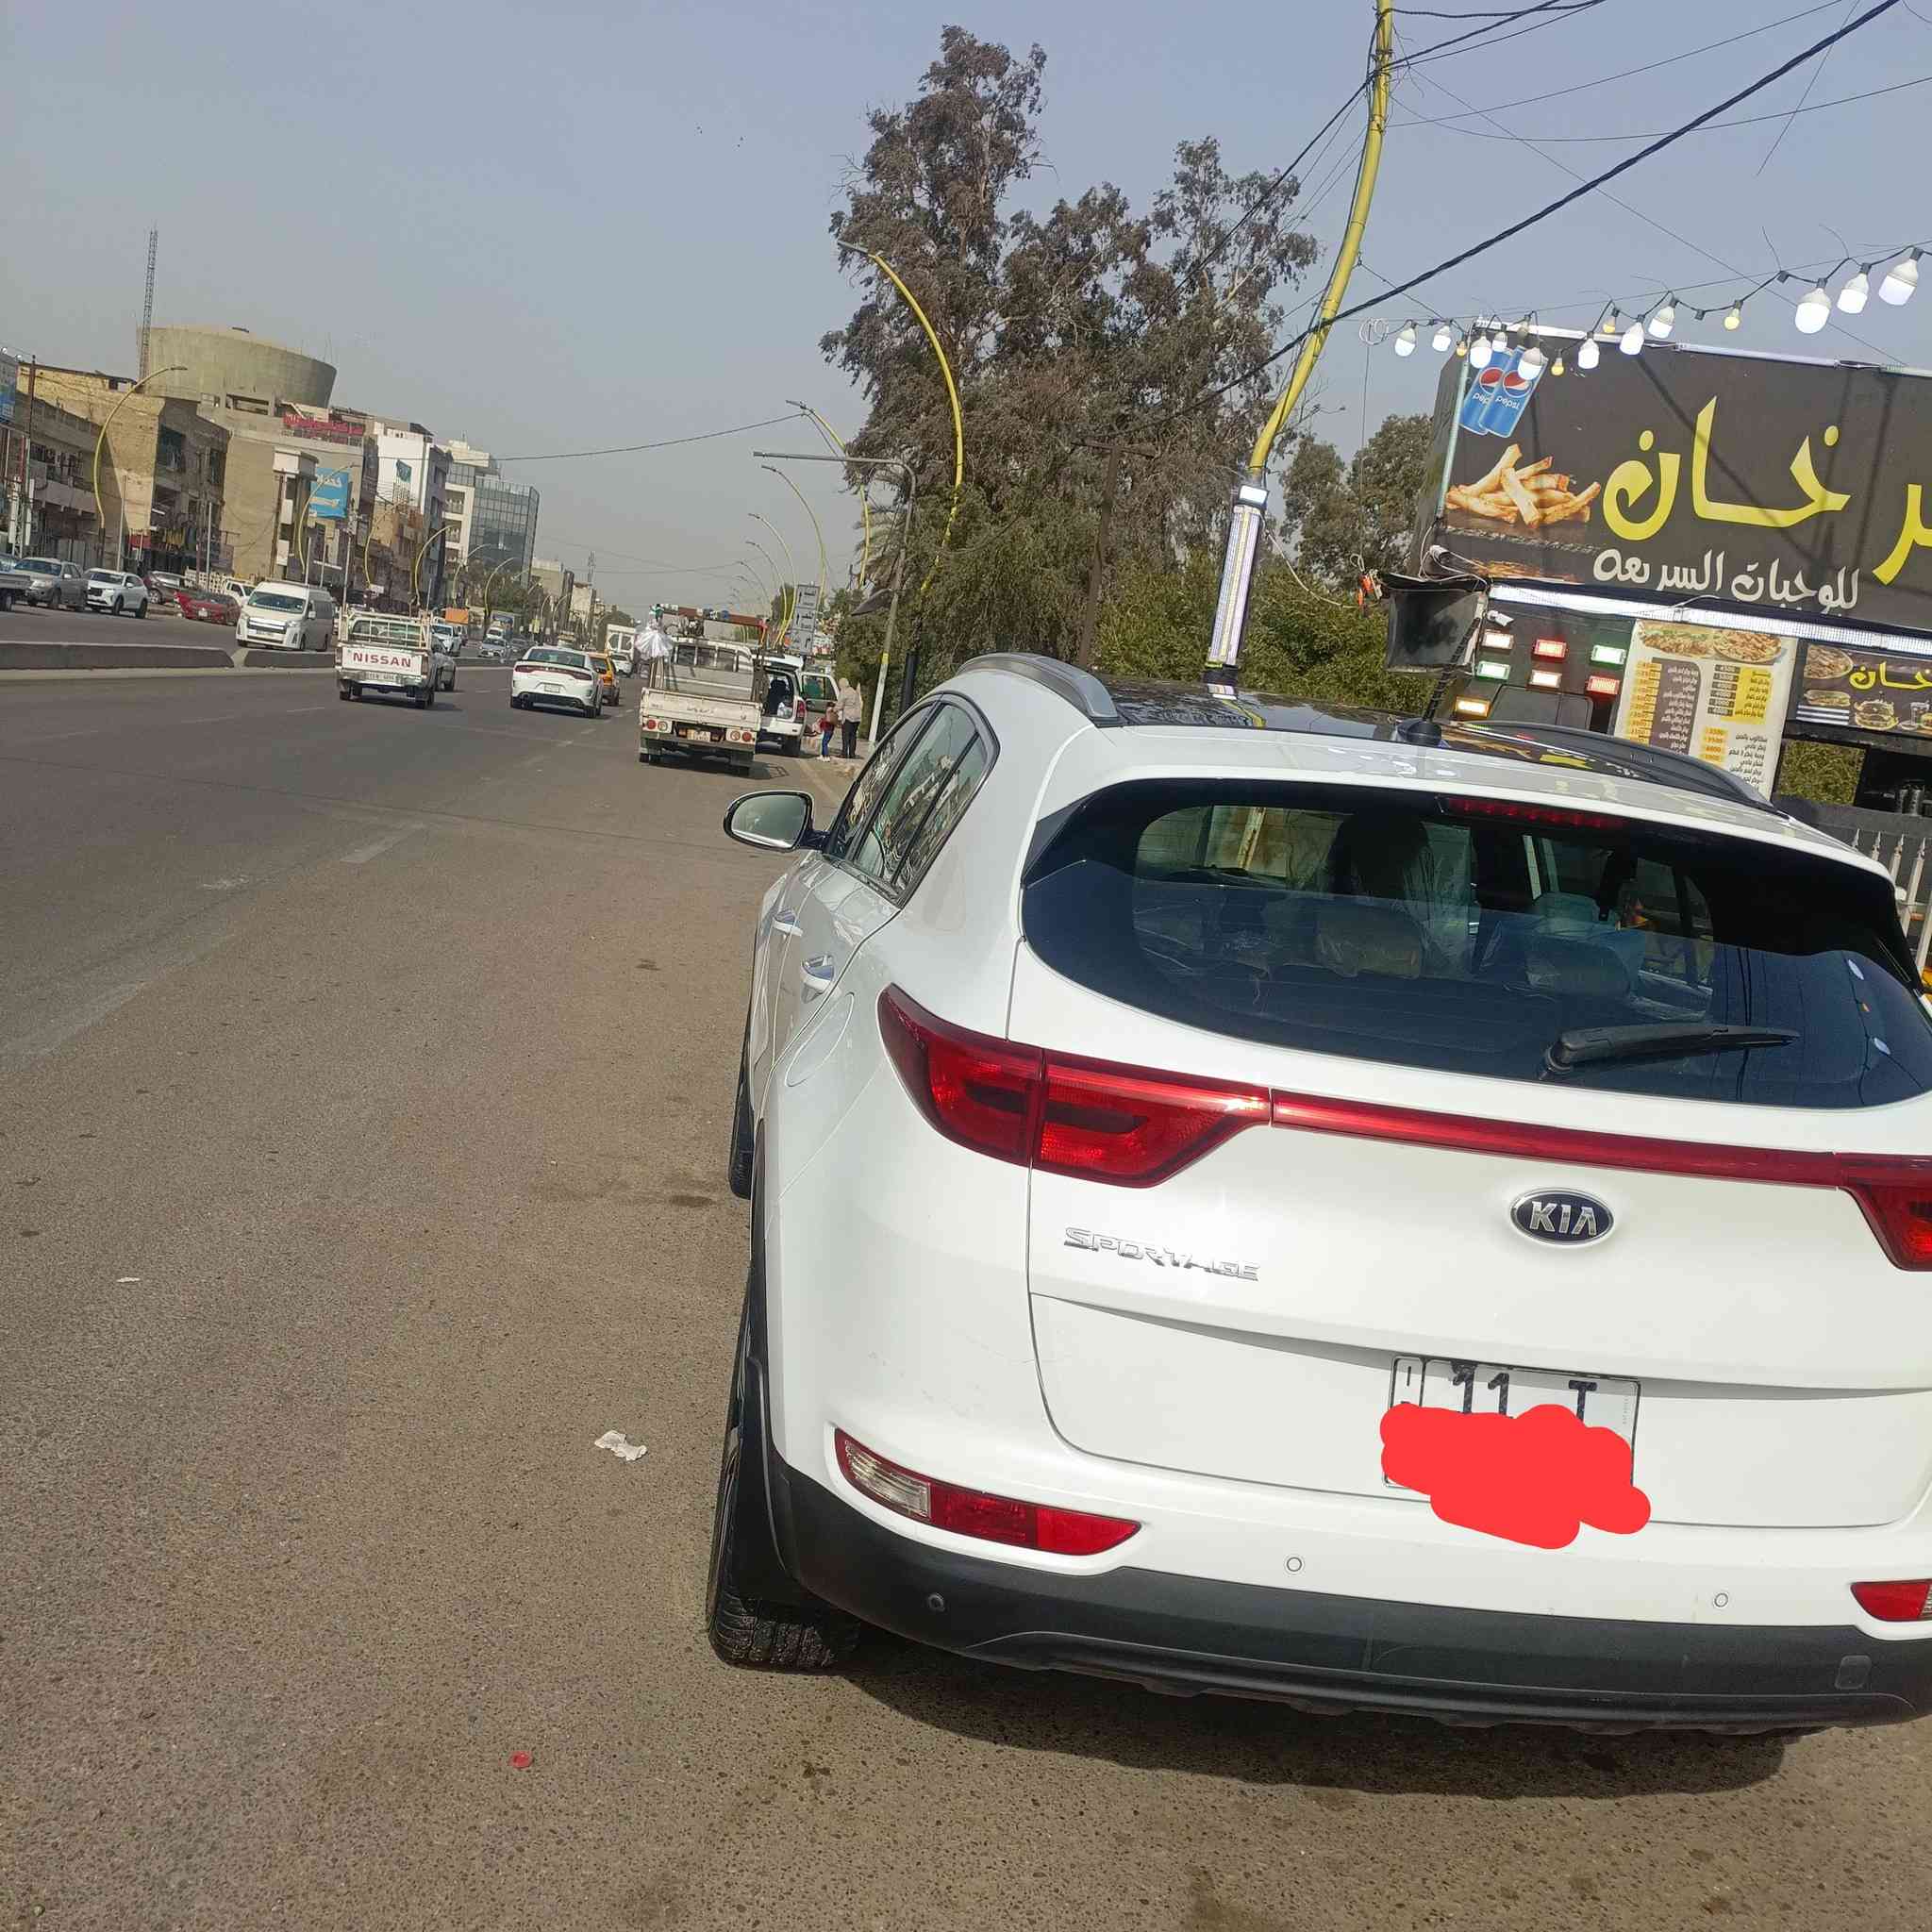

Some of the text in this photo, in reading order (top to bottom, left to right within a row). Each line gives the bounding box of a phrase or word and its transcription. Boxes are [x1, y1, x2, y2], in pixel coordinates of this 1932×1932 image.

[1603, 395, 1851, 541] خان
[353, 652, 411, 668] NISSAN
[1529, 1199, 1599, 1236] KIA
[1063, 1226, 1260, 1283] SPORTAGE
